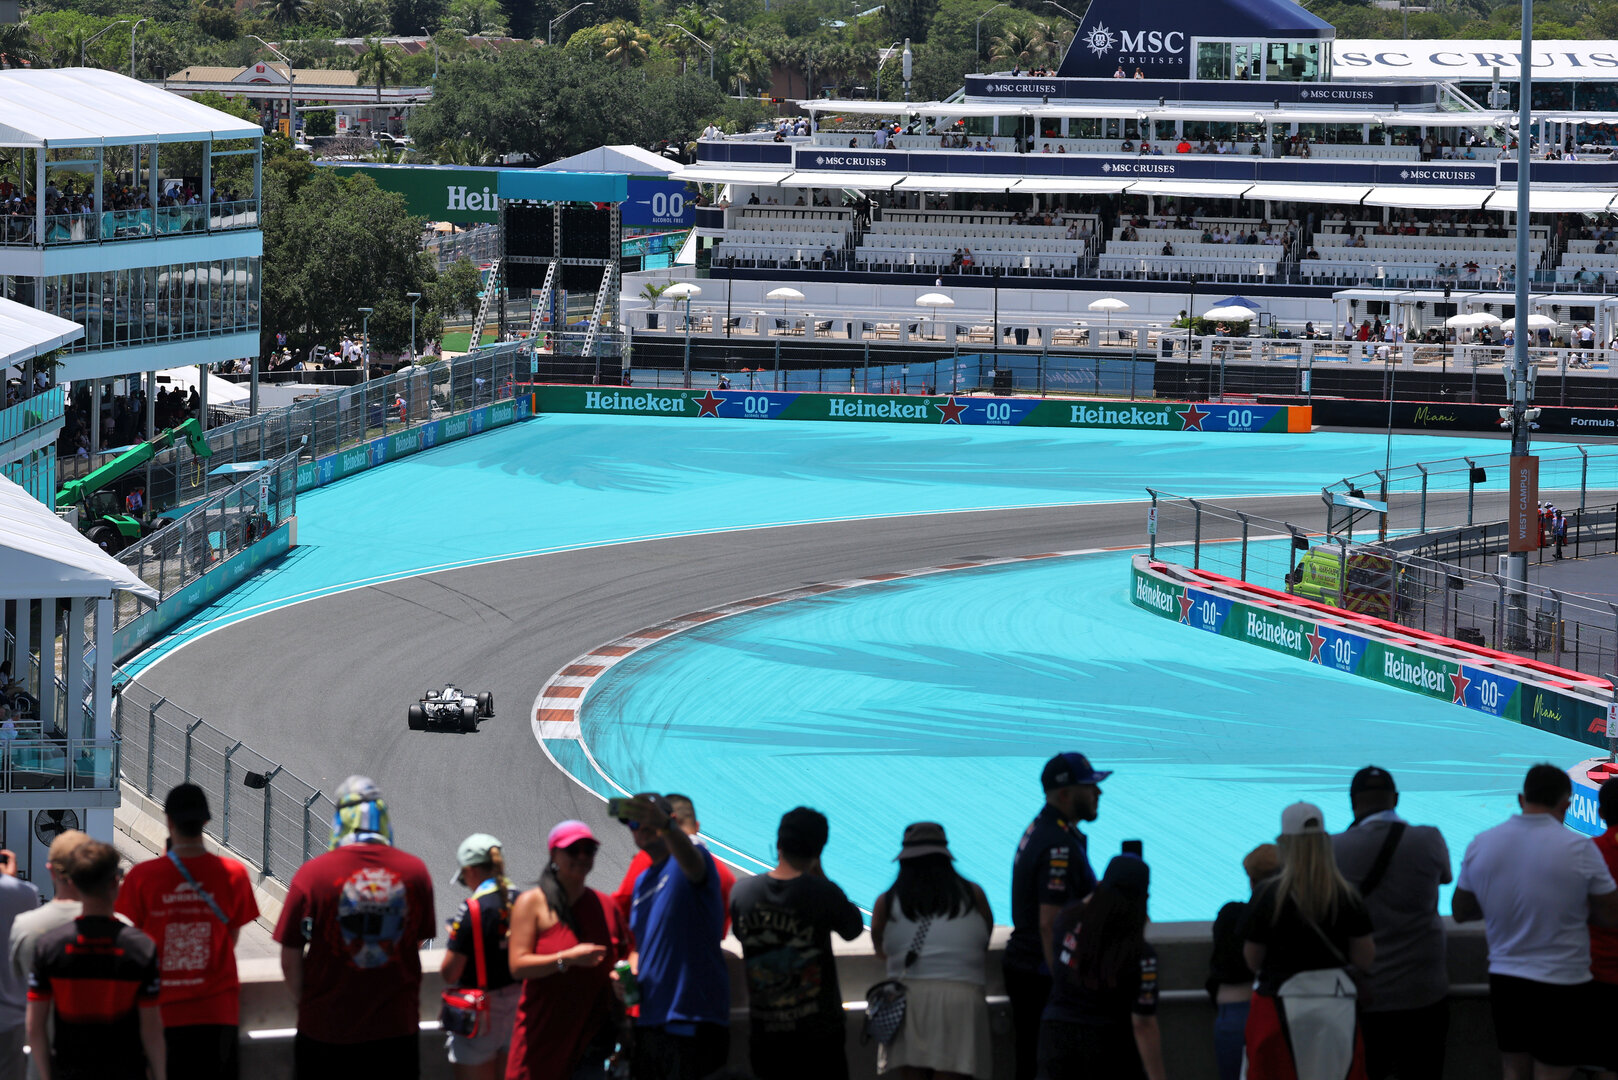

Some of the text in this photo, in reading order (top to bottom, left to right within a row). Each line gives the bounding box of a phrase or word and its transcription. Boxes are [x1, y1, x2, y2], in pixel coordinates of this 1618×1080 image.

[1120, 30, 1184, 53] MSC
[1118, 56, 1183, 65] CRUISES
[1333, 51, 1413, 67] SC
[995, 84, 1056, 93] MSC CRUISES
[1310, 90, 1374, 99] MSC CRUISES
[825, 156, 887, 166] MSC CRUISES
[1111, 164, 1175, 173] MSC CRUISES
[1410, 170, 1476, 180] MSC CRUISES
[585, 391, 686, 412] Heineken
[828, 399, 929, 419] Heineken
[1070, 405, 1170, 426] Heineken
[1413, 406, 1457, 426] Miami
[1570, 417, 1615, 427] Formula
[1519, 468, 1529, 540] WEST CAMPUS
[1136, 575, 1216, 626] Heineken 0.0
[1246, 611, 1351, 664] Heineken 0.0
[1384, 650, 1498, 708] Heineken 0.0
[1533, 693, 1562, 724] Miami
